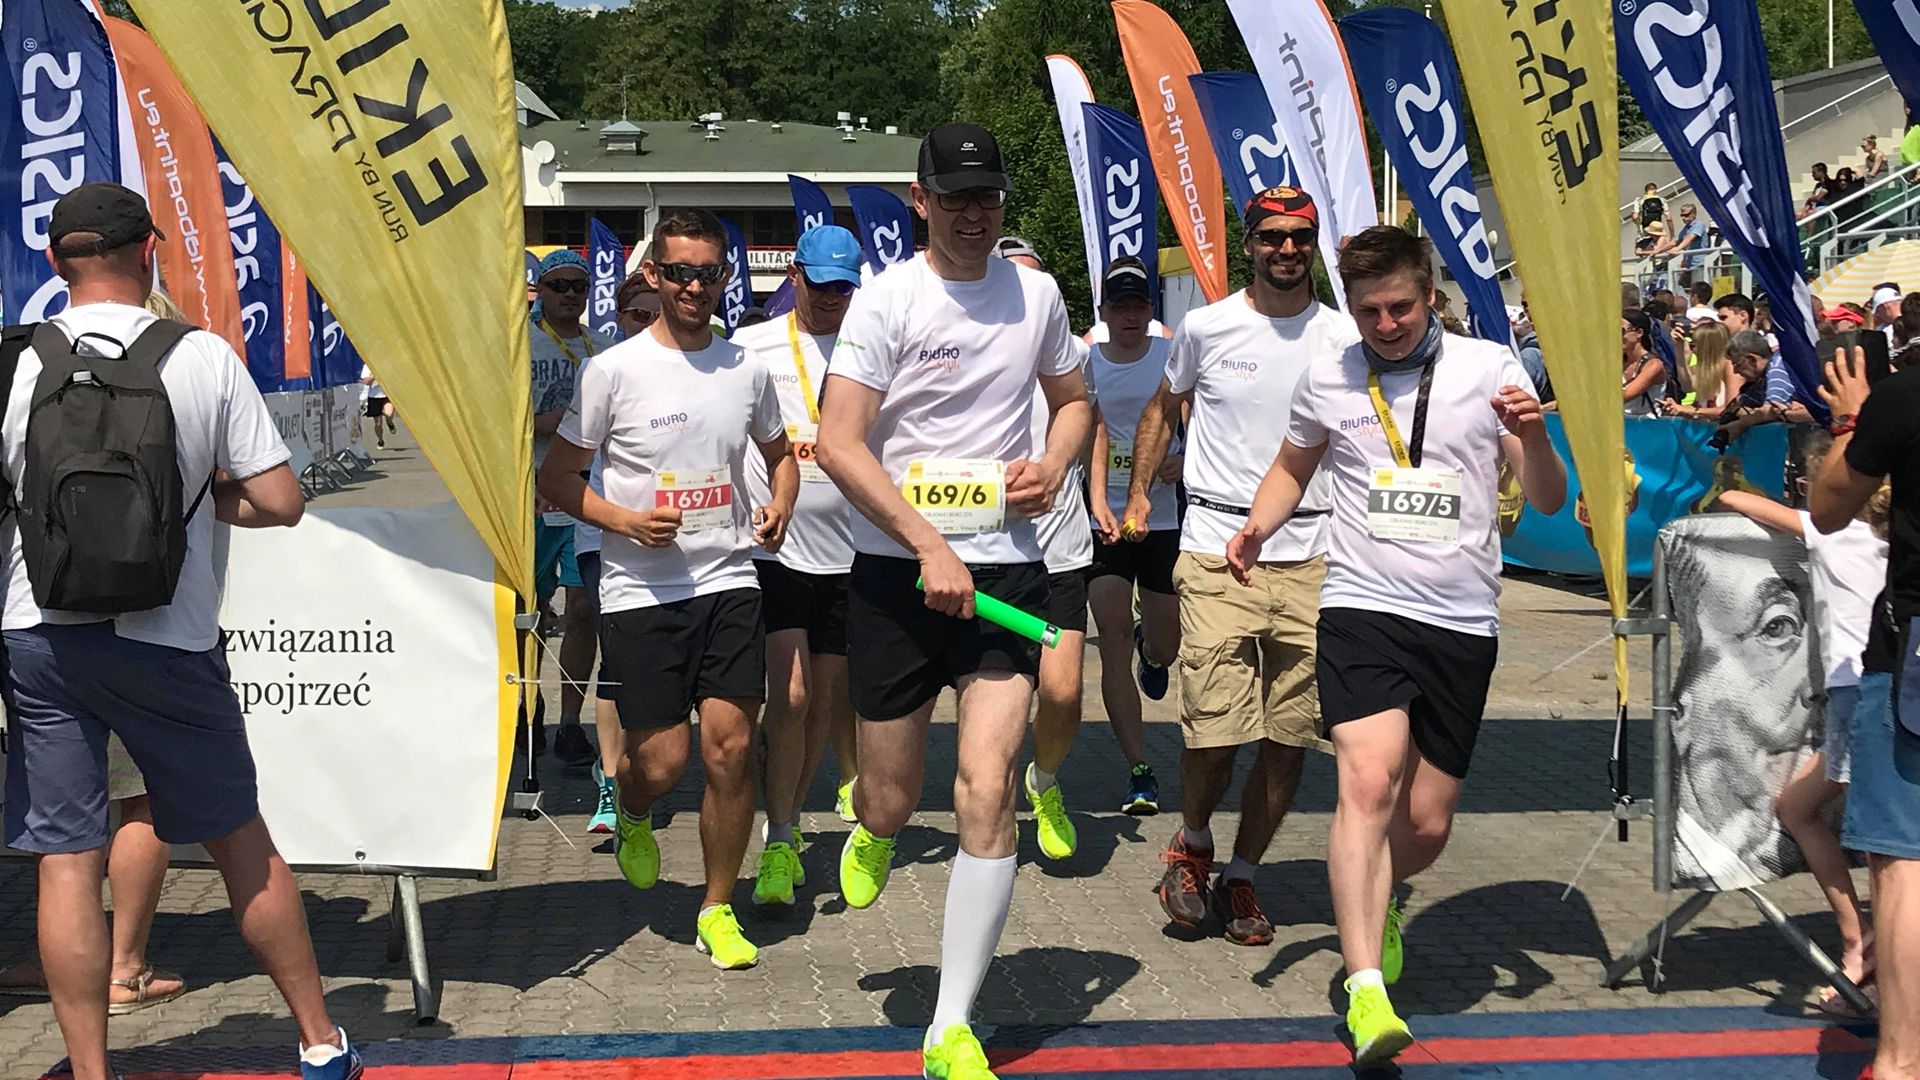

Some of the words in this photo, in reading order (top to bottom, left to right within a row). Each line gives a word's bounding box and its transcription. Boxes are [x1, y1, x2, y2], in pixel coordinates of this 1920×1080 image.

[919, 347, 960, 361] BIURO
[1221, 359, 1258, 372] BIURO
[650, 412, 688, 429] BIURO
[1340, 414, 1381, 430] BIURO
[665, 487, 723, 509] 169/1
[912, 484, 987, 507] 169/6
[1380, 491, 1452, 516] 169/5
[224, 618, 396, 662] związania
